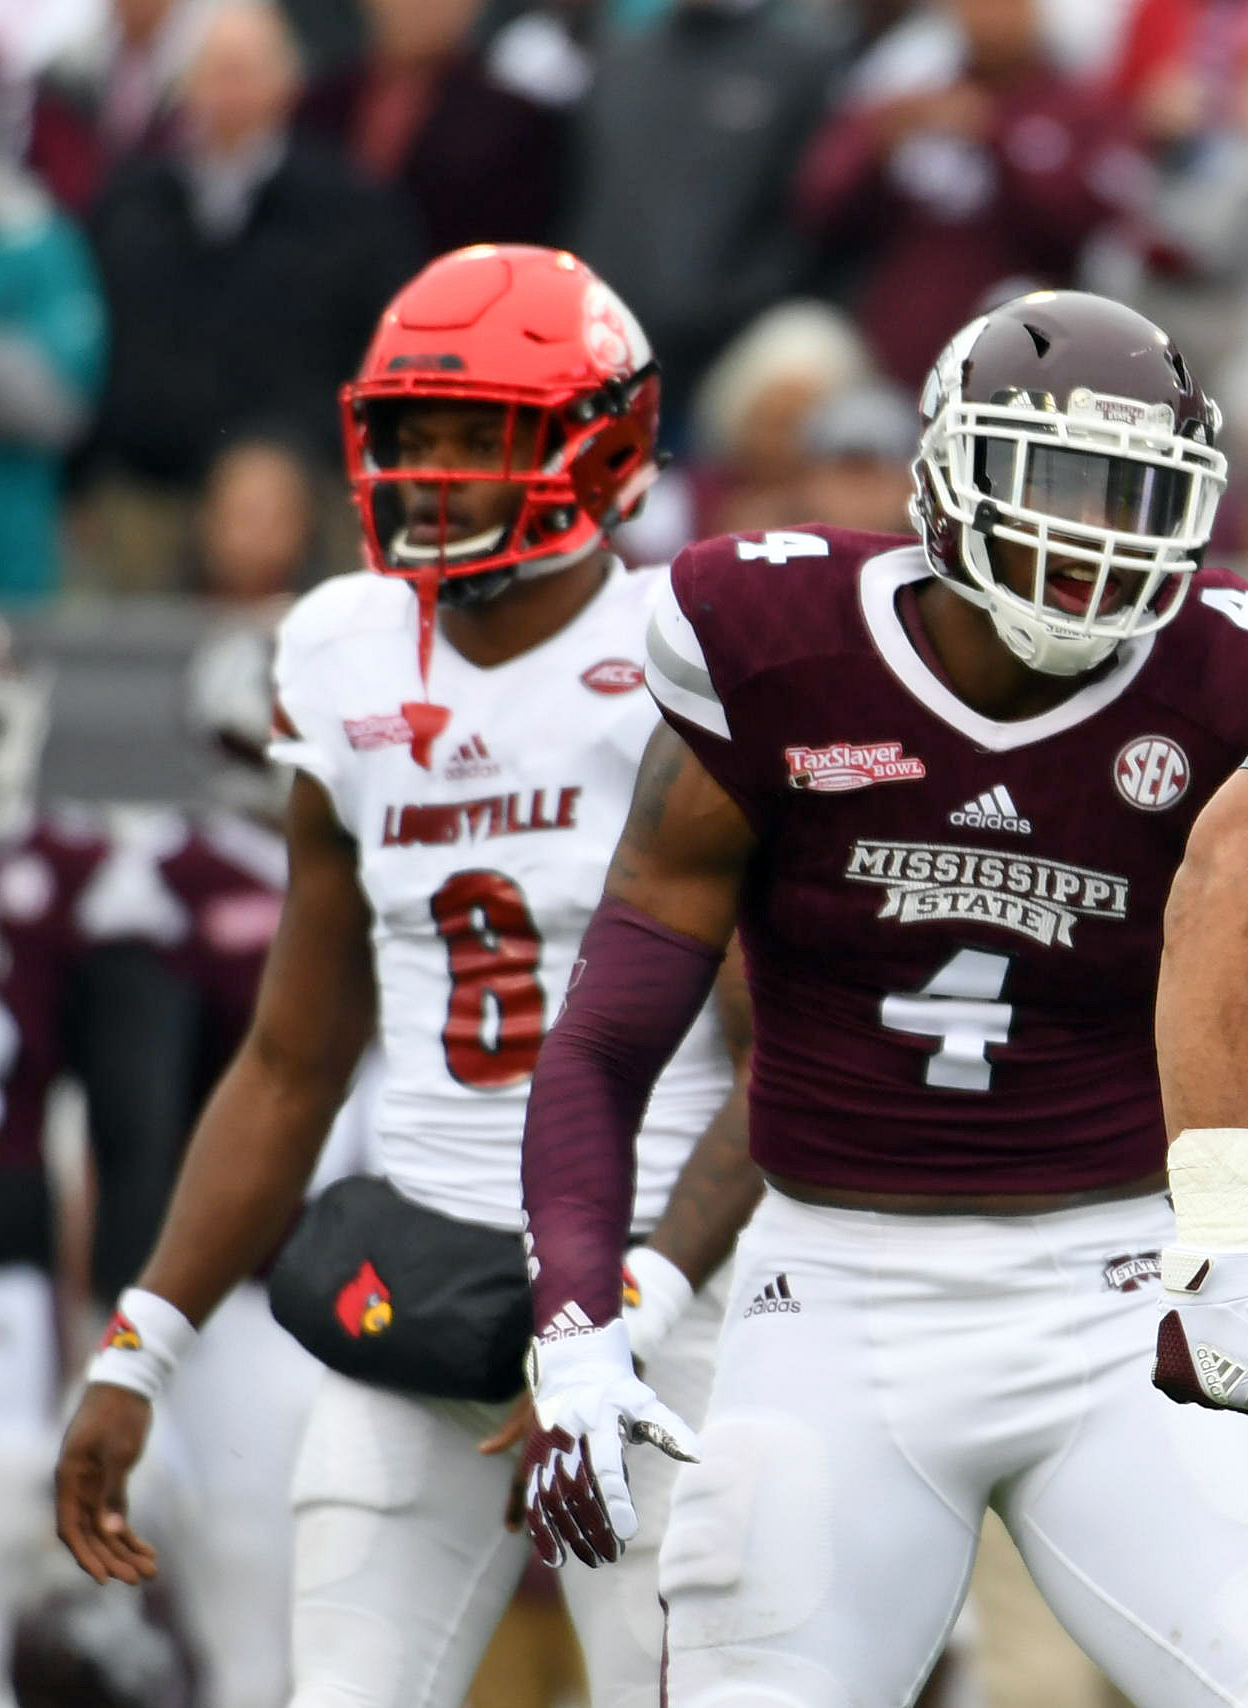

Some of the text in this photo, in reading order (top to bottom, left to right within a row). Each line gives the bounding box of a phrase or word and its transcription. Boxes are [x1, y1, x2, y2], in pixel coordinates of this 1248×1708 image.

[737, 531, 830, 564] 4
[788, 746, 922, 777] TaxSlayer BOWL
[1120, 741, 1184, 806] SEC
[949, 811, 1032, 834] adidas
[848, 846, 1128, 911] MISSISSIPPI
[916, 892, 1041, 932] STATE
[429, 868, 547, 1092] 8
[881, 948, 1012, 1091] 4
[1115, 1258, 1162, 1282] STATE
